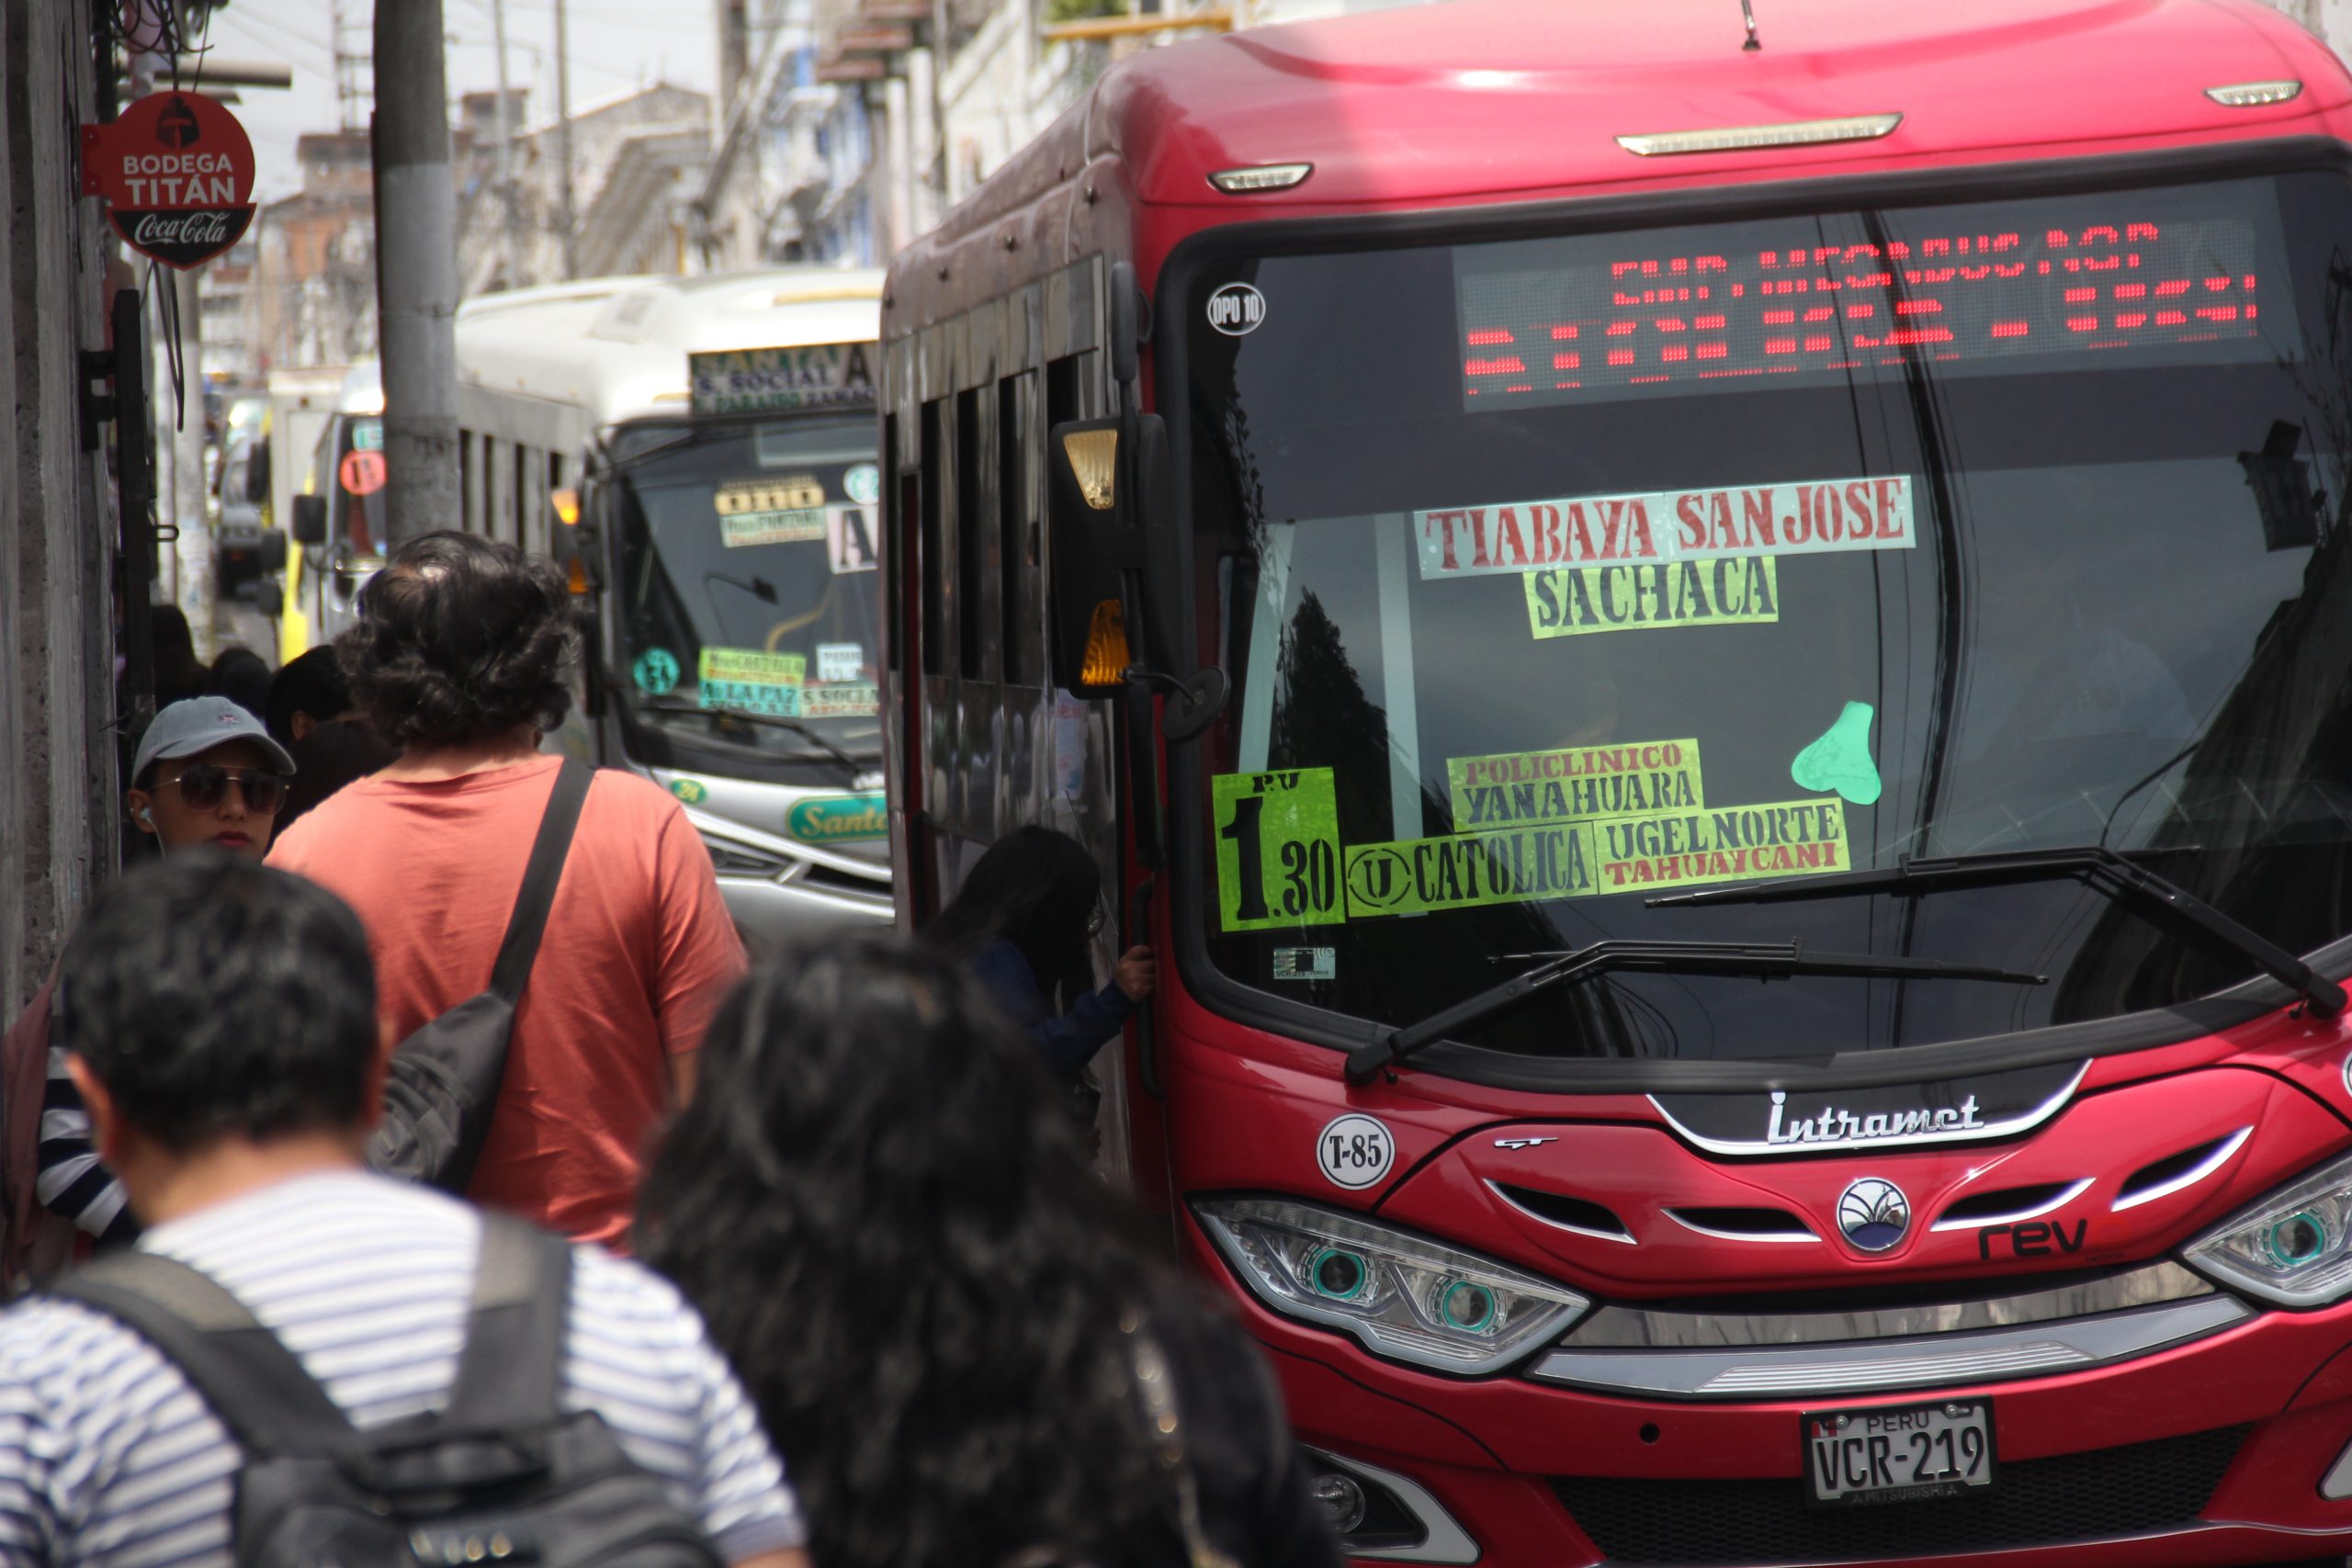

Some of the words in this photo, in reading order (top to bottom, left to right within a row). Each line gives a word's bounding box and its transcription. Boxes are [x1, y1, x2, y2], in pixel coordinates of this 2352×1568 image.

[123, 154, 232, 175] BODEGA
[125, 174, 235, 206] TITÁN
[134, 211, 230, 244] Coca-Cola
[1213, 295, 1240, 324] OPO
[1244, 294, 1260, 322] 10
[729, 367, 836, 392] SOCIAL
[844, 343, 872, 386] A
[1426, 499, 1657, 570] TIABAYA
[1676, 488, 1775, 551] SAN
[1782, 479, 1905, 543] JOSE
[840, 510, 878, 567] A
[1535, 557, 1776, 628] SACHACA
[1465, 743, 1682, 785] POLICLINICO
[1464, 770, 1697, 824] YANAHUARA
[1606, 815, 1711, 860] UGEL
[1713, 804, 1839, 852] NORTE
[1413, 829, 1590, 903] CATOLICA
[1604, 841, 1838, 886] TAHUAYCANI
[1329, 1134, 1382, 1169] T-85
[1868, 1412, 1930, 1434] PERU
[1816, 1426, 1984, 1491] VCR-219
[1865, 1483, 1945, 1504] MITSUBISHI
